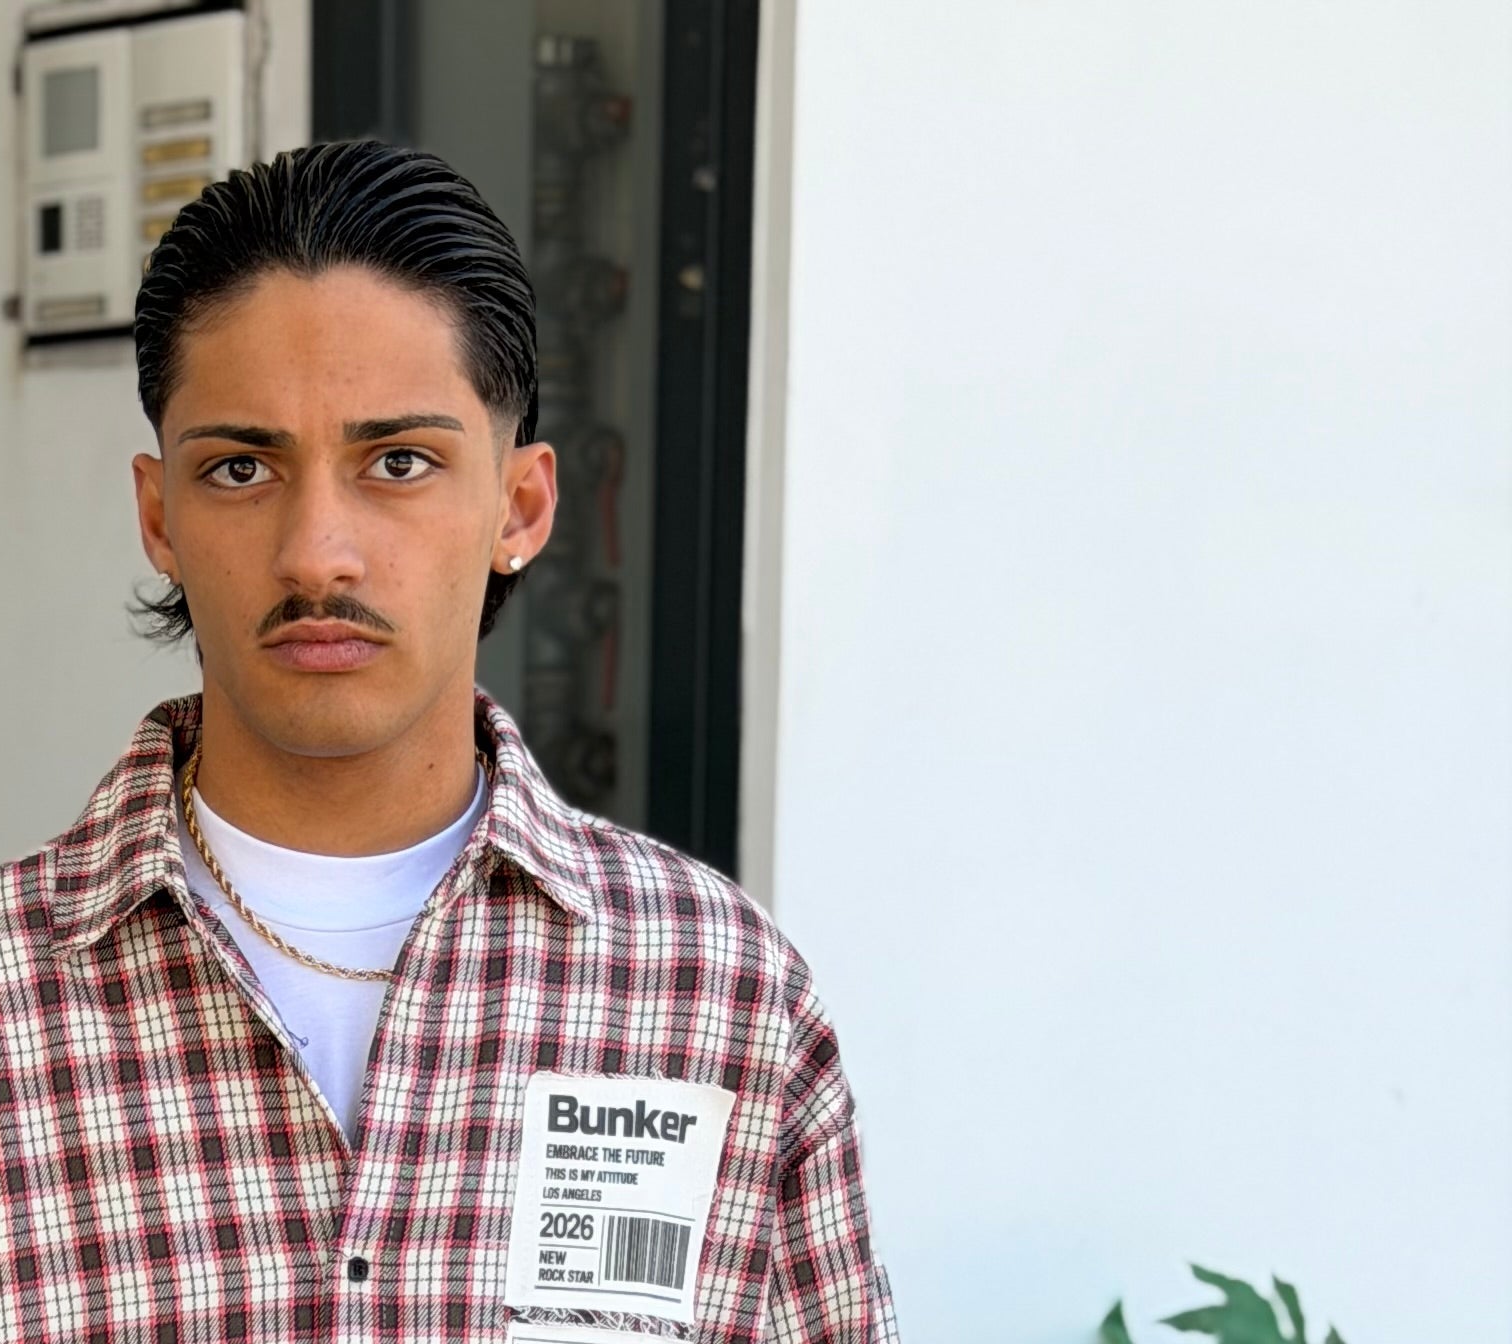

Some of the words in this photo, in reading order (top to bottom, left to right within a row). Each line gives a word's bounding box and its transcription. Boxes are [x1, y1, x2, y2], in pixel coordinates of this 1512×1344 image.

[547, 1094, 698, 1144] Bunker
[546, 1144, 599, 1161] EMBRACE
[602, 1147, 622, 1163] THE
[625, 1149, 665, 1166] FUTURE
[545, 1167, 566, 1181] THIS
[568, 1169, 579, 1181] IS
[580, 1170, 595, 1183] MY
[597, 1171, 638, 1185] ATTITUDE
[543, 1187, 560, 1200] LOS
[562, 1188, 602, 1202] ANGELES
[539, 1212, 594, 1240] 2026
[539, 1251, 567, 1265] NEW
[538, 1269, 565, 1283] ROCK
[567, 1270, 594, 1283] STAR
